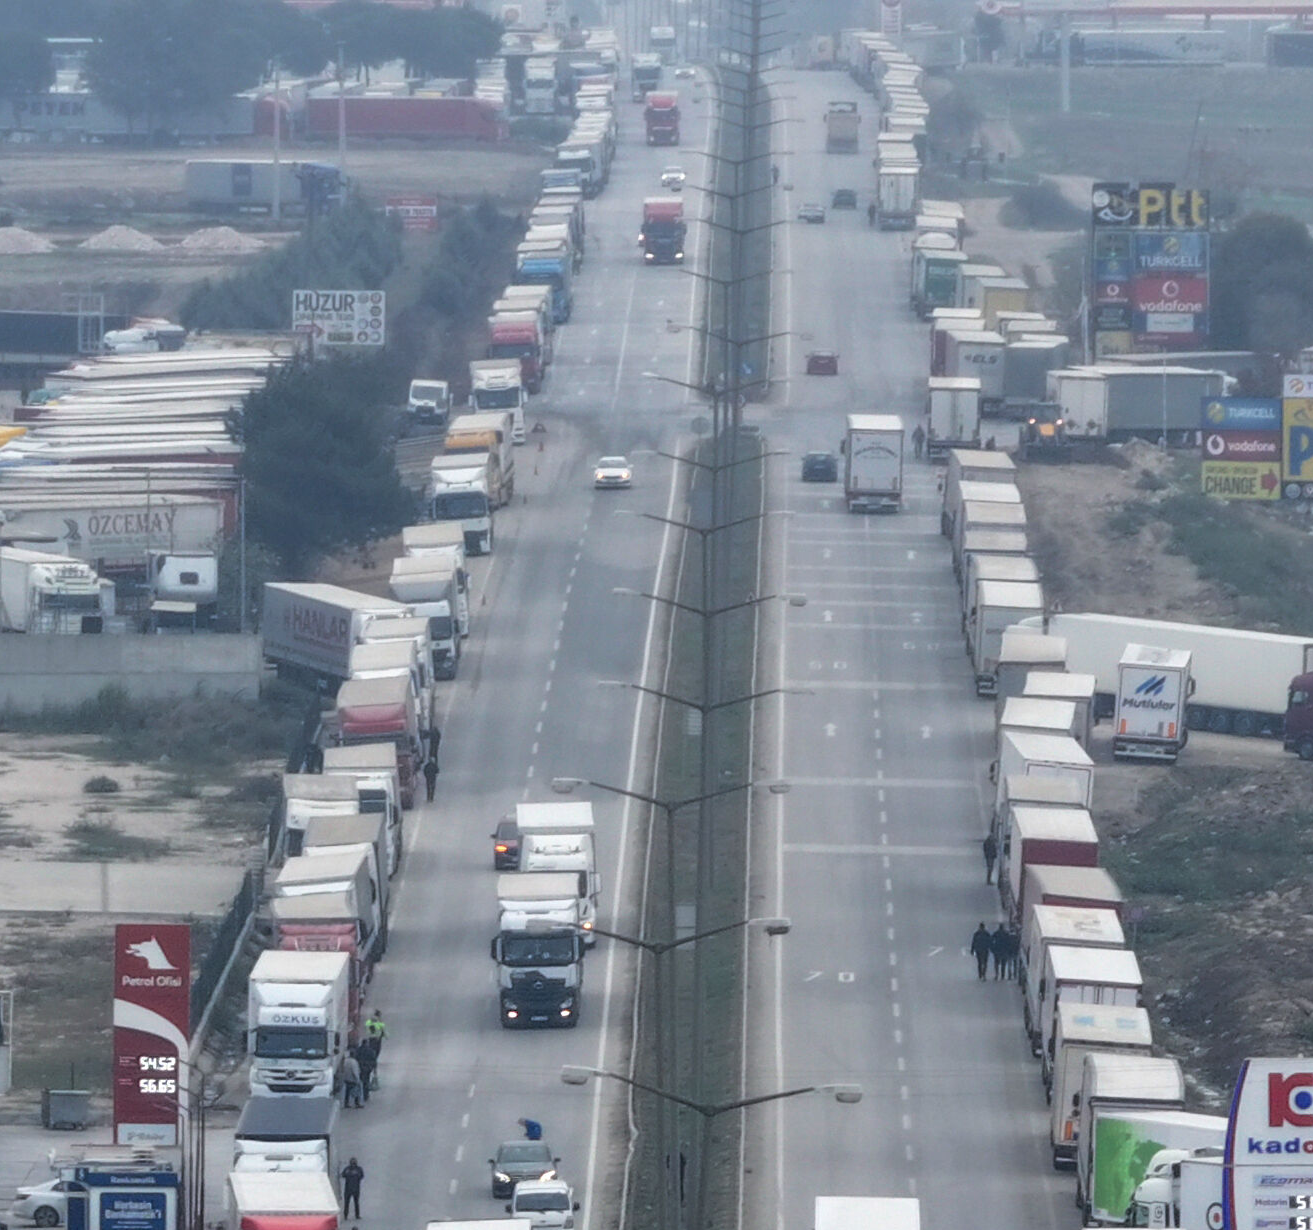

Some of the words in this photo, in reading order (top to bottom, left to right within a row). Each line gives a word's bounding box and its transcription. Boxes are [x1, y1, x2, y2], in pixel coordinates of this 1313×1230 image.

[1139, 189, 1205, 225] Ptt
[295, 293, 355, 313] HUZUR
[1139, 301, 1203, 312] vodafone
[1227, 438, 1276, 452] vodafone
[1205, 477, 1257, 495] CHANGE
[122, 976, 154, 986] Petrol
[156, 976, 181, 986] Ofisi
[139, 1057, 176, 1071] 54.52
[139, 1079, 176, 1093] 56.65
[1254, 1198, 1288, 1207] Motorin
